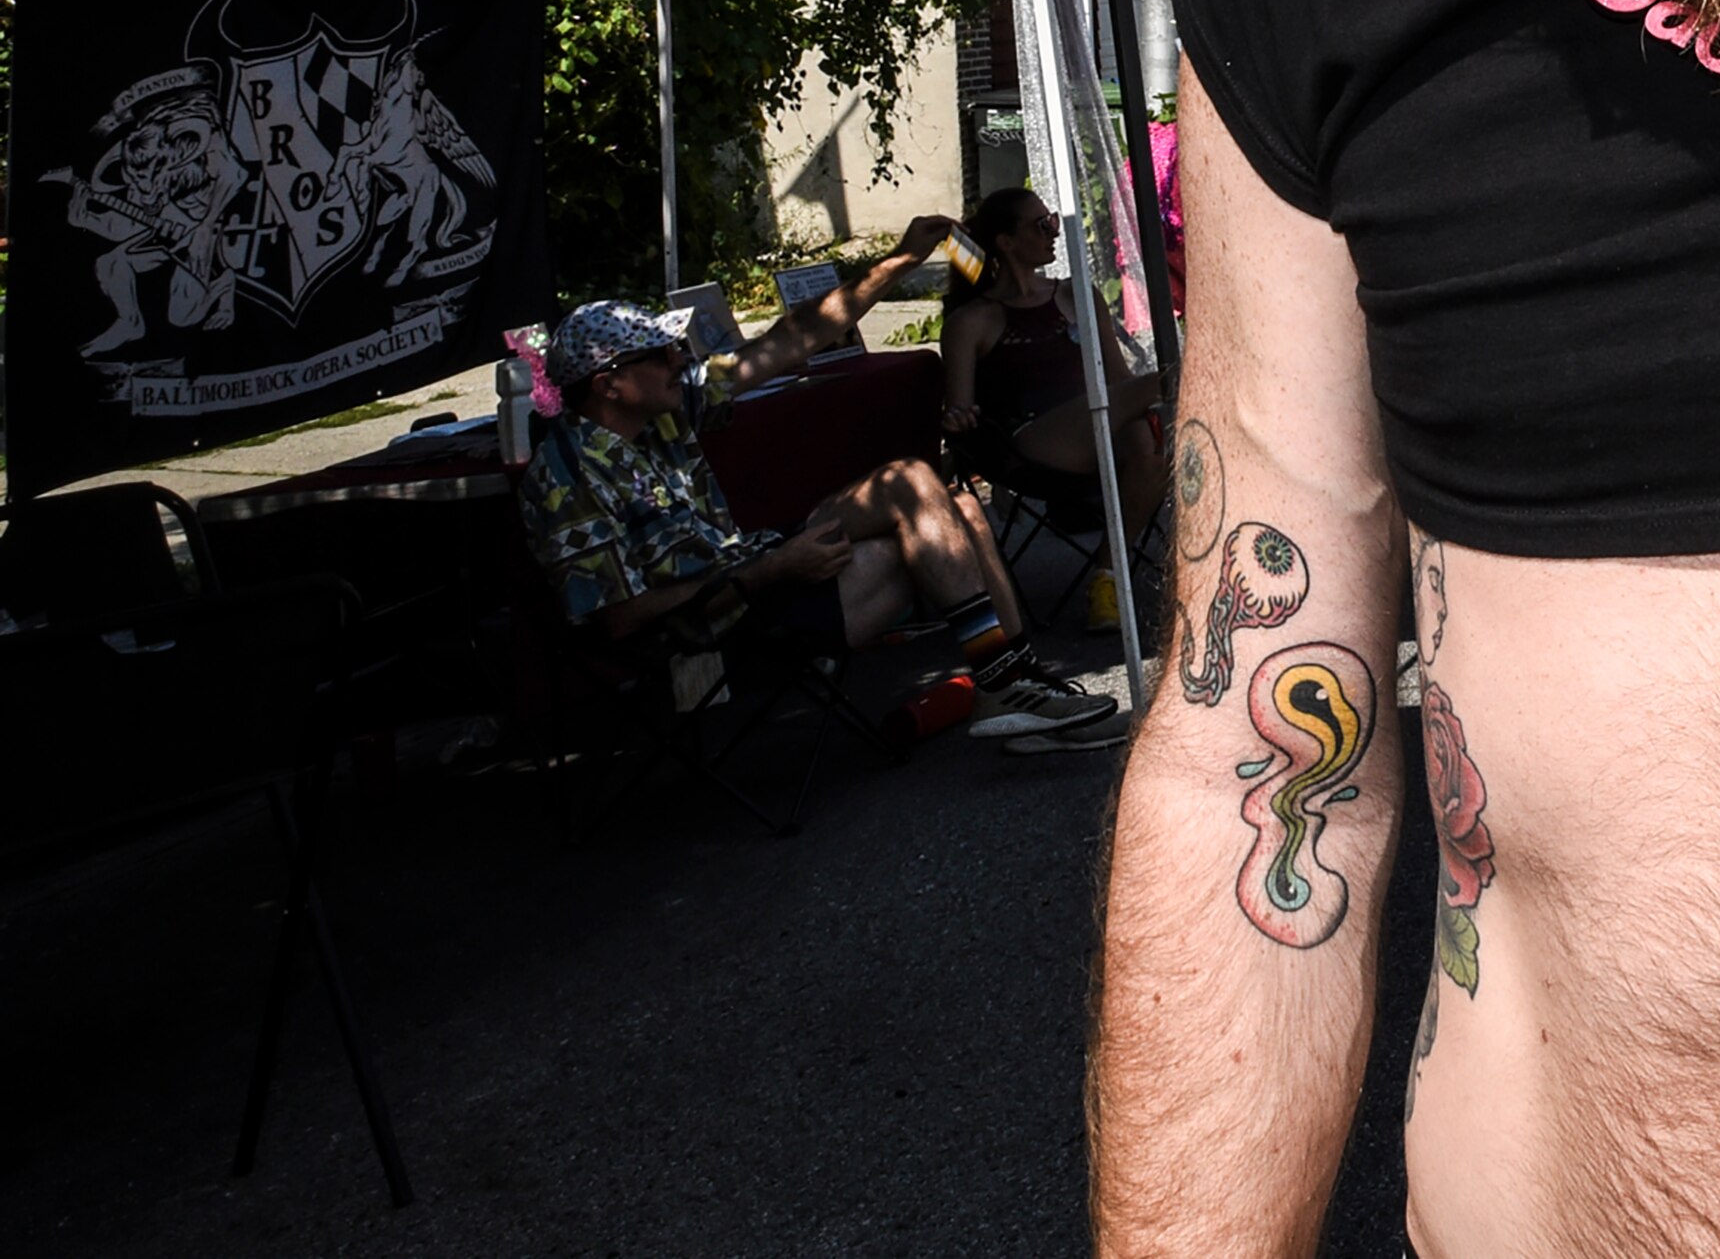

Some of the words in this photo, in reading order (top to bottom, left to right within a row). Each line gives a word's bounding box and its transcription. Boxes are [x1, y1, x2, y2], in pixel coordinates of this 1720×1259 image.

[248, 79, 344, 248] BROS
[141, 378, 253, 406] BALTIMORE
[255, 368, 297, 394] ROCK
[302, 352, 354, 385] OPERA
[356, 322, 432, 364] SOCIETY
